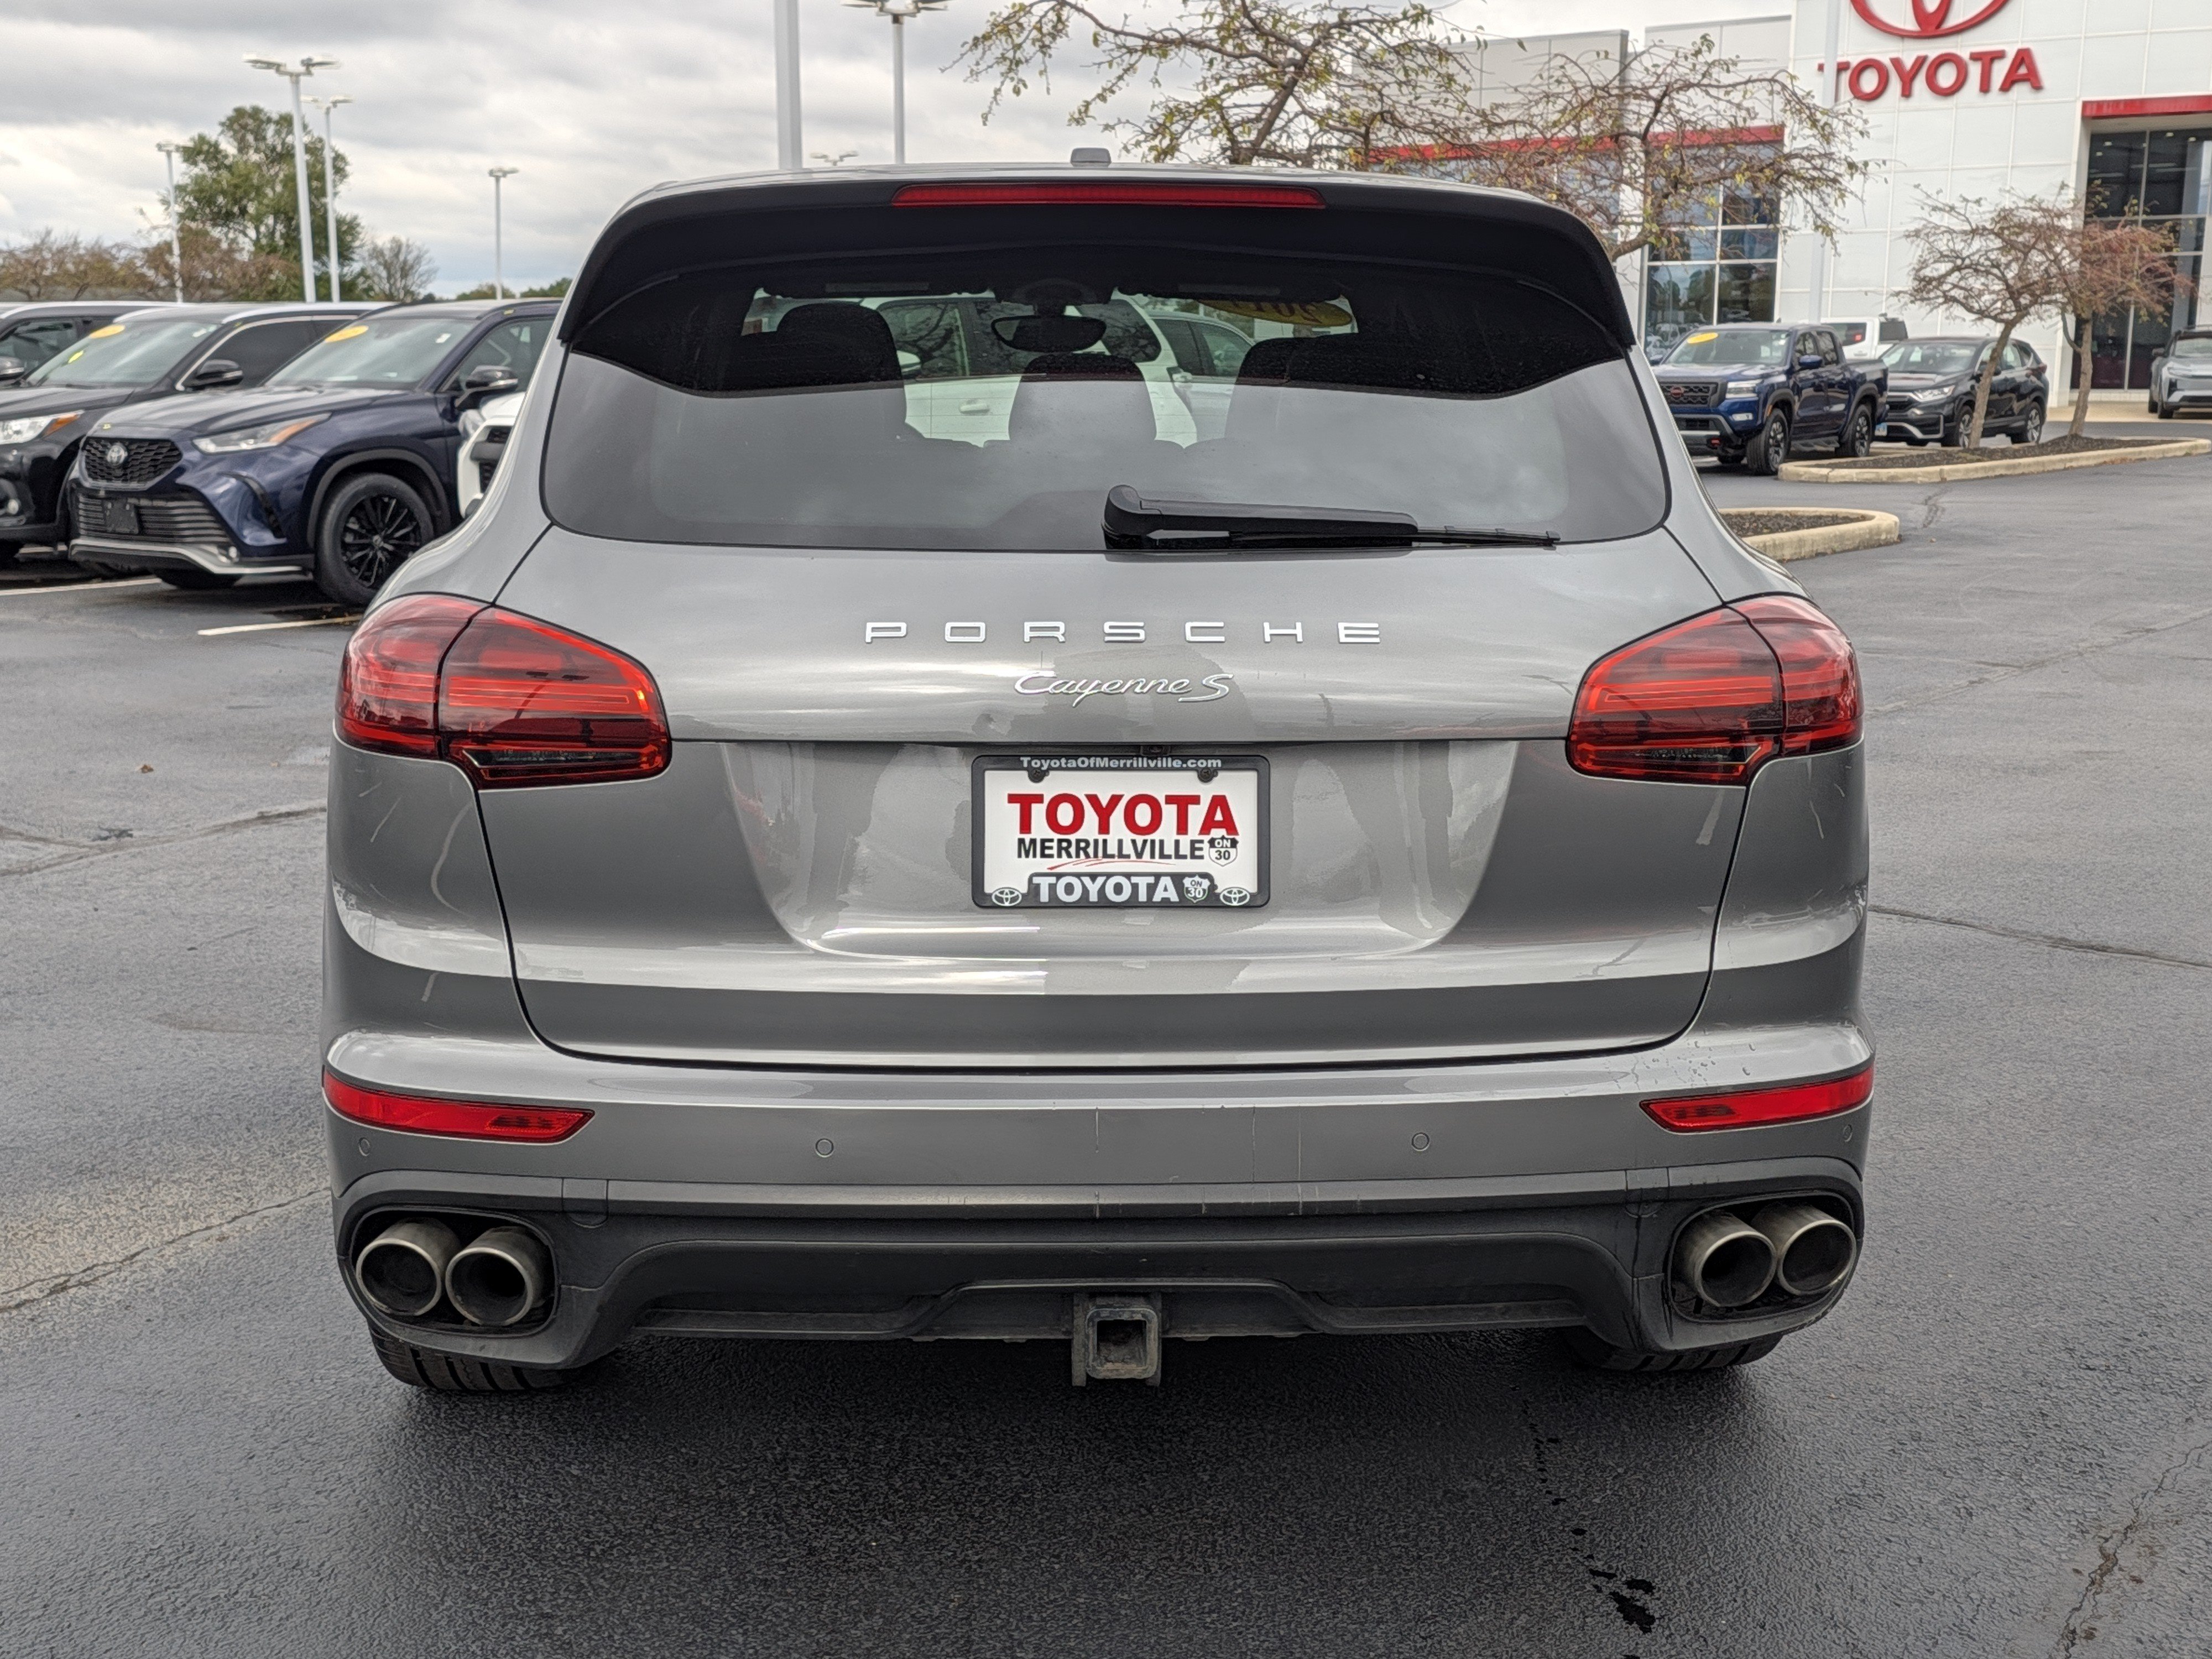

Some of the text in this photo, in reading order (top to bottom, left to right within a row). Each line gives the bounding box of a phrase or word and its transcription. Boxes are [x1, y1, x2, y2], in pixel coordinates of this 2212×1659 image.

[865, 620, 1381, 643] PORSCHE
[1014, 670, 1234, 707] Cayenne S
[1020, 757, 1222, 769] ToyotaOfMerrillville.com
[1008, 793, 1239, 836] TOYOTA
[1017, 838, 1204, 859] MERRILLVILLE
[1215, 839, 1230, 847] ON
[1215, 850, 1230, 860] 30
[1032, 876, 1180, 902] TOYOTA
[1187, 888, 1203, 898] 30
